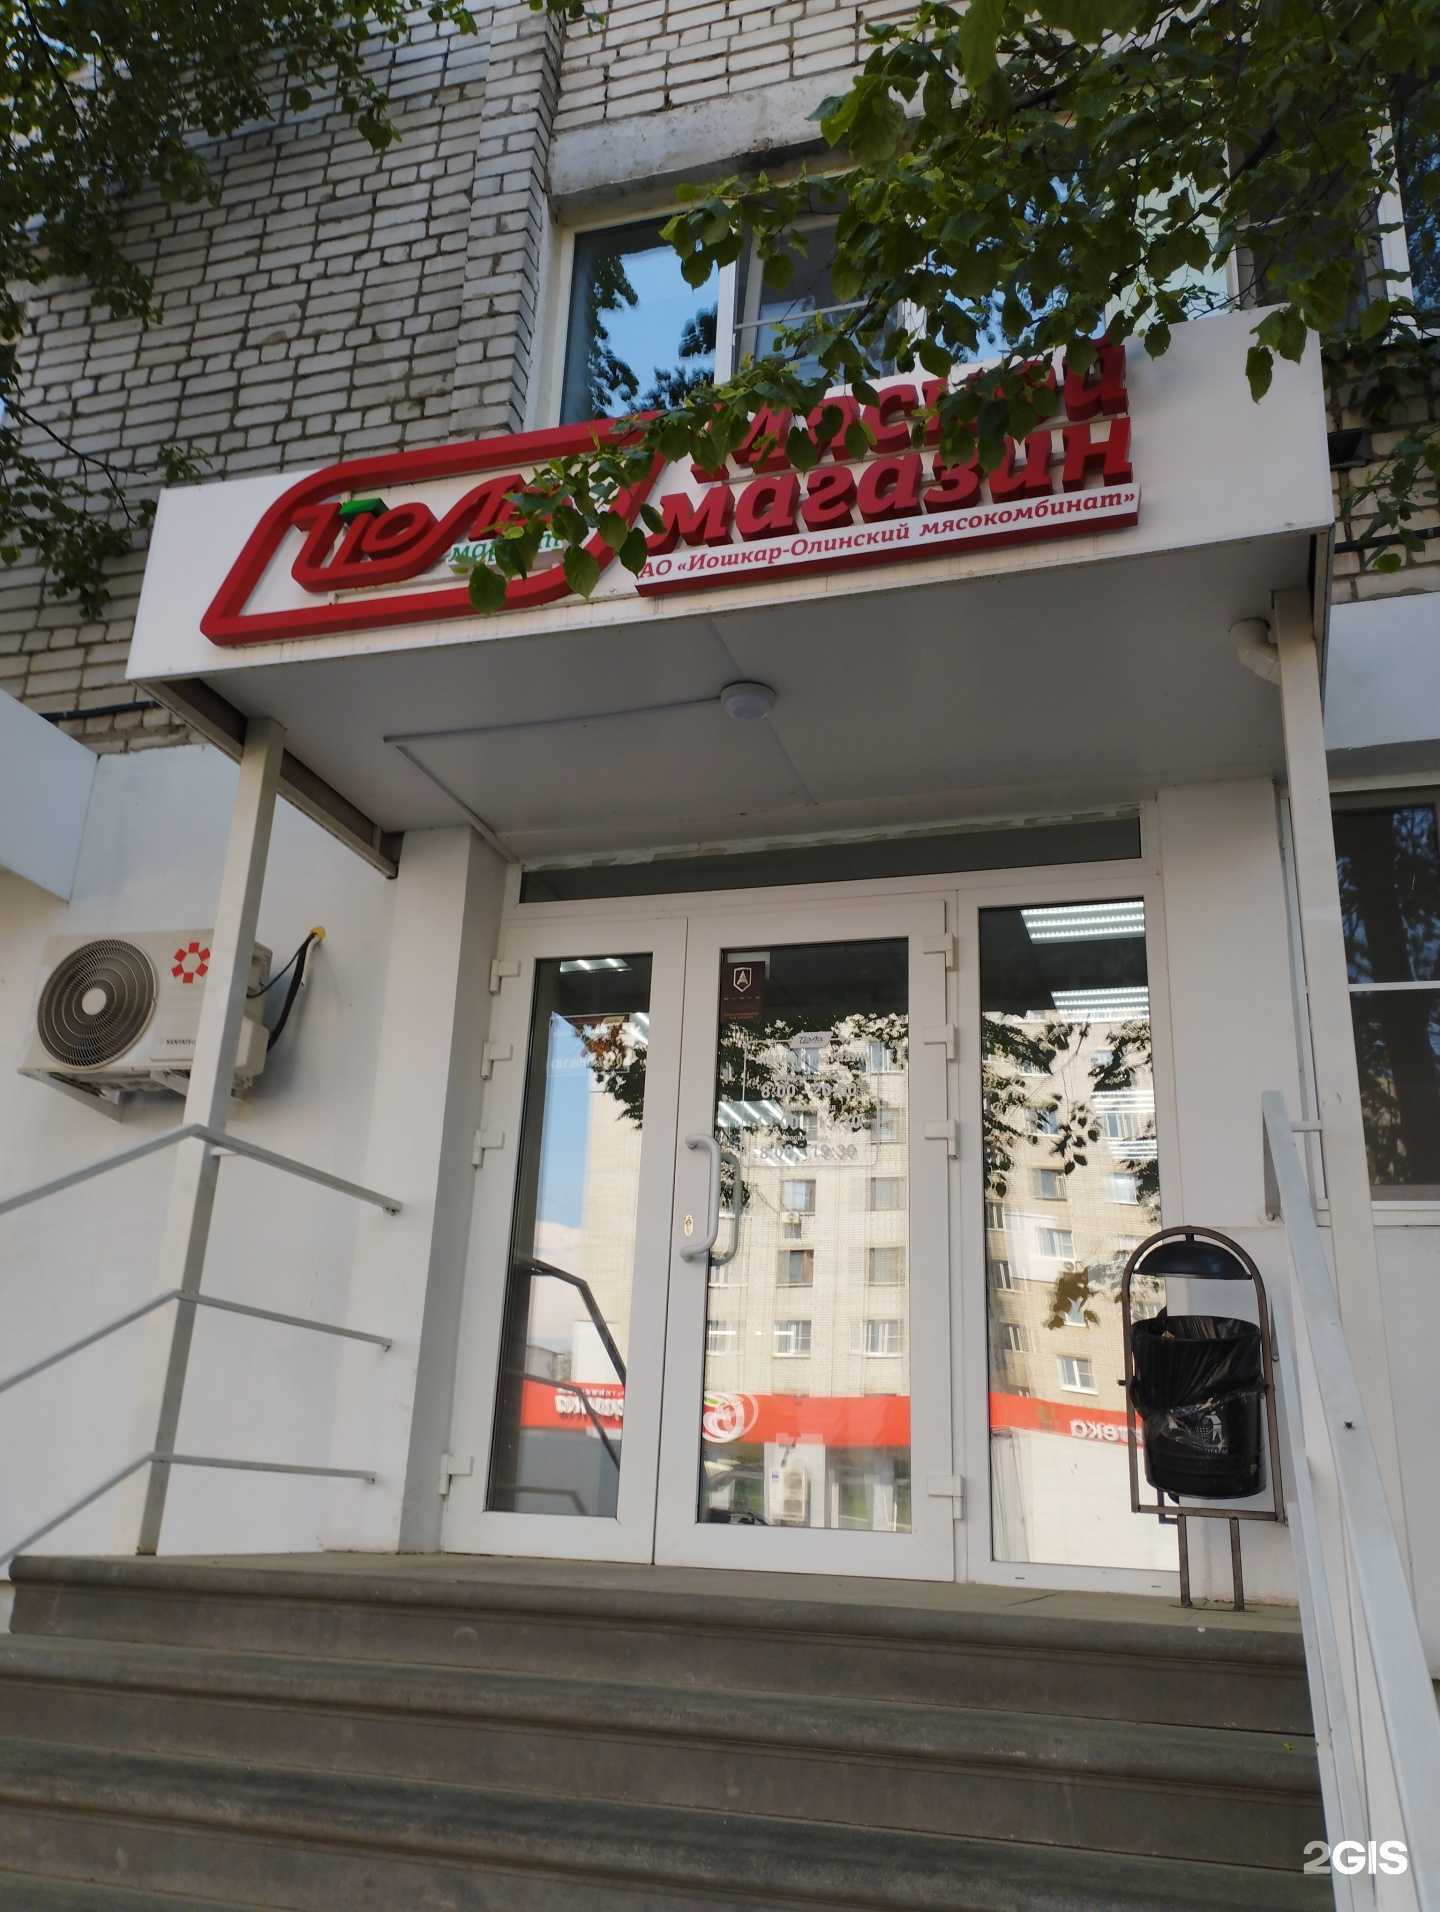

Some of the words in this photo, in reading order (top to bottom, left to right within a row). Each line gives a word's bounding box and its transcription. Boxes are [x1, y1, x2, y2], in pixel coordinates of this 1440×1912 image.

[639, 559, 673, 579] АО
[919, 490, 1136, 537] мясокомбинат»
[644, 417, 1133, 556] магазин
